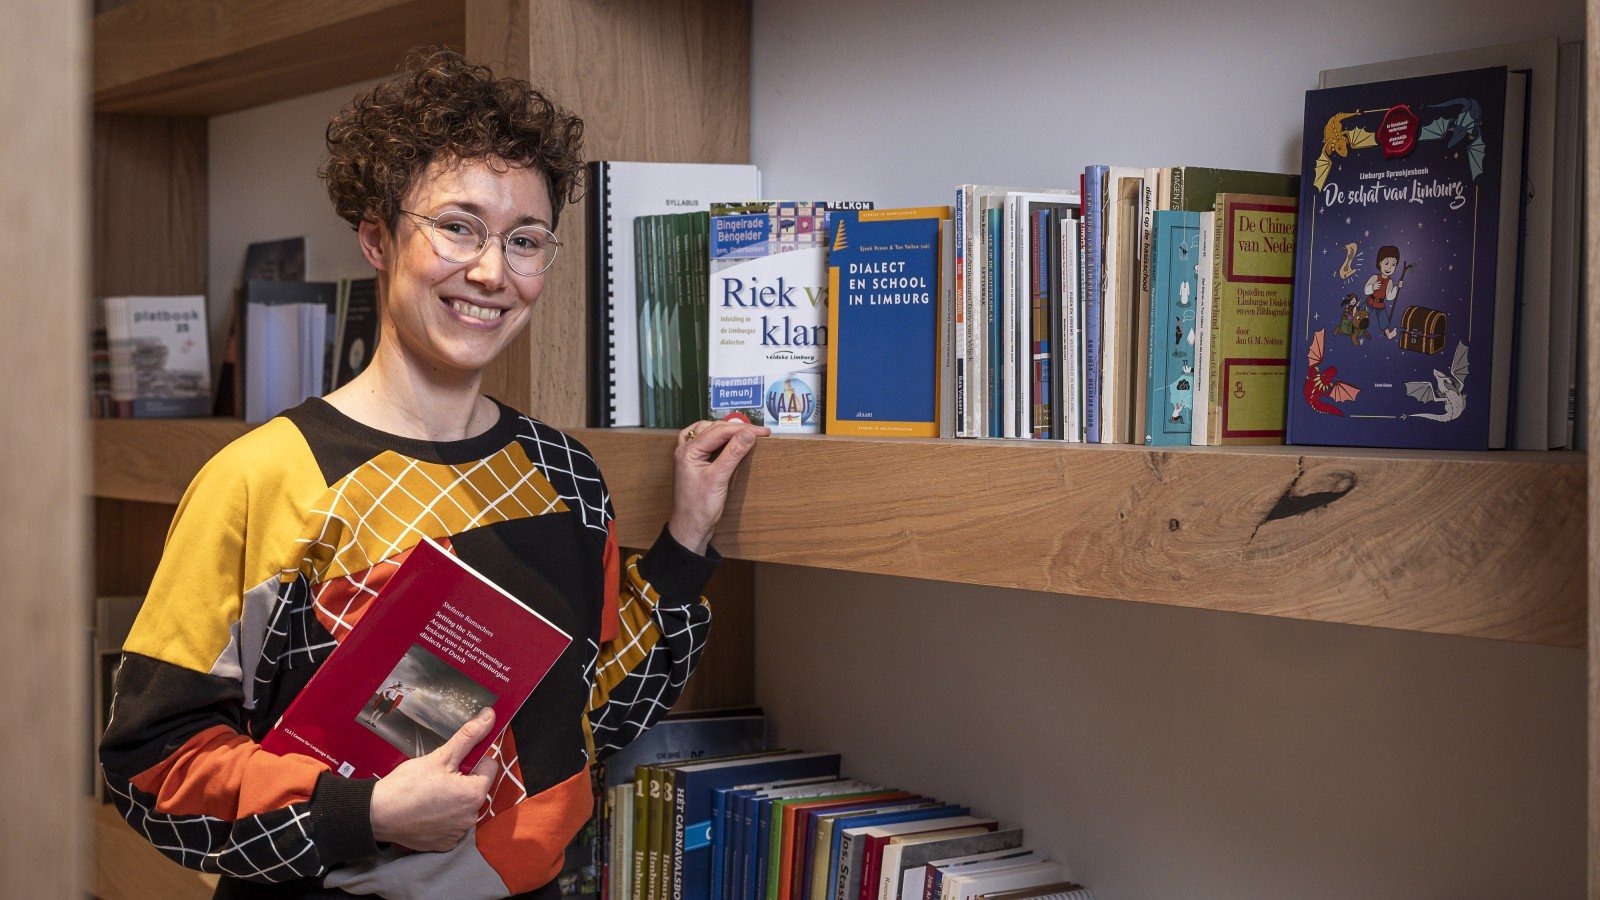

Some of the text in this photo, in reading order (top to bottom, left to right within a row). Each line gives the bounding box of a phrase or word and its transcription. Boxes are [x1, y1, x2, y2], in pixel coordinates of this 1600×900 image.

[1360, 168, 1429, 181] Limburgs Sprookjesboek
[1172, 171, 1181, 211] HAGEN/S
[1323, 179, 1466, 210] De schat van Limburg
[826, 202, 870, 210] WELKOM
[1217, 203, 1224, 216] De
[717, 218, 764, 232] Bingelrade
[1144, 217, 1150, 228] op
[1238, 216, 1297, 234] De Chinez
[1144, 230, 1150, 241] de
[988, 248, 993, 259] OP
[1238, 240, 1260, 252] van
[850, 262, 906, 274] DIALECT
[988, 260, 993, 269] DE
[1142, 242, 1150, 292] basisschool
[720, 276, 797, 307] Riek
[850, 277, 926, 290] EN SCHOOL
[850, 292, 929, 305] IN LIMBURG
[1212, 281, 1221, 330] Nederland
[966, 303, 974, 322] Tony
[760, 316, 828, 346] klan
[1236, 326, 1248, 336] door
[1236, 336, 1247, 344] Jan
[715, 376, 758, 388] Roermond
[720, 387, 753, 398] Remunj
[435, 611, 482, 643] Setting the Tone:
[442, 601, 494, 638] Stefanie Ramachers
[420, 631, 441, 648] dialects
[448, 650, 466, 664] Dutch
[430, 618, 462, 640] Acquisition
[462, 640, 474, 648] and
[472, 646, 503, 668] processing
[424, 624, 445, 640] lexical
[444, 638, 458, 648] tone
[464, 650, 510, 682] East-Limburgian
[293, 733, 305, 742] Centre
[310, 744, 326, 757] Language
[326, 754, 339, 766] Studies
[636, 780, 644, 798] 1
[650, 780, 660, 798] 2
[664, 782, 672, 802] 3
[674, 787, 686, 900] HÉT CARNAVALSBO
[842, 832, 852, 860] Jos.
[633, 850, 644, 900] limburg
[926, 874, 934, 888] Jos
